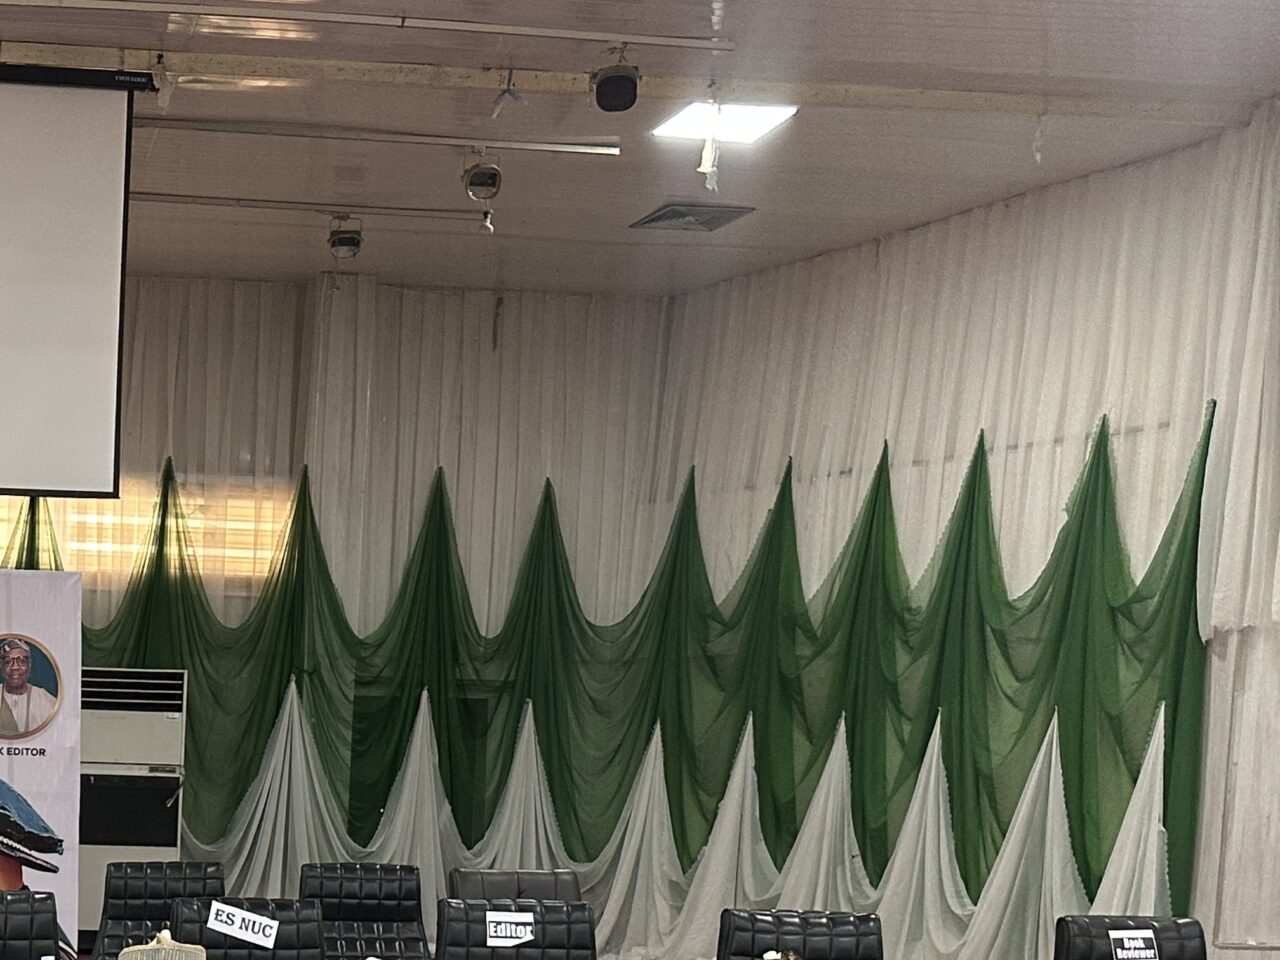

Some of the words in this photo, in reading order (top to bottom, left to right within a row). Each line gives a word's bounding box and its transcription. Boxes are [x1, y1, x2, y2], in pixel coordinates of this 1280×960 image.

[7, 746, 46, 757] EDITOR
[214, 908, 235, 926] ES
[239, 917, 273, 938] NUC
[489, 922, 532, 938] Editor
[1123, 937, 1145, 948] Book
[1116, 947, 1155, 959] Reviewer
